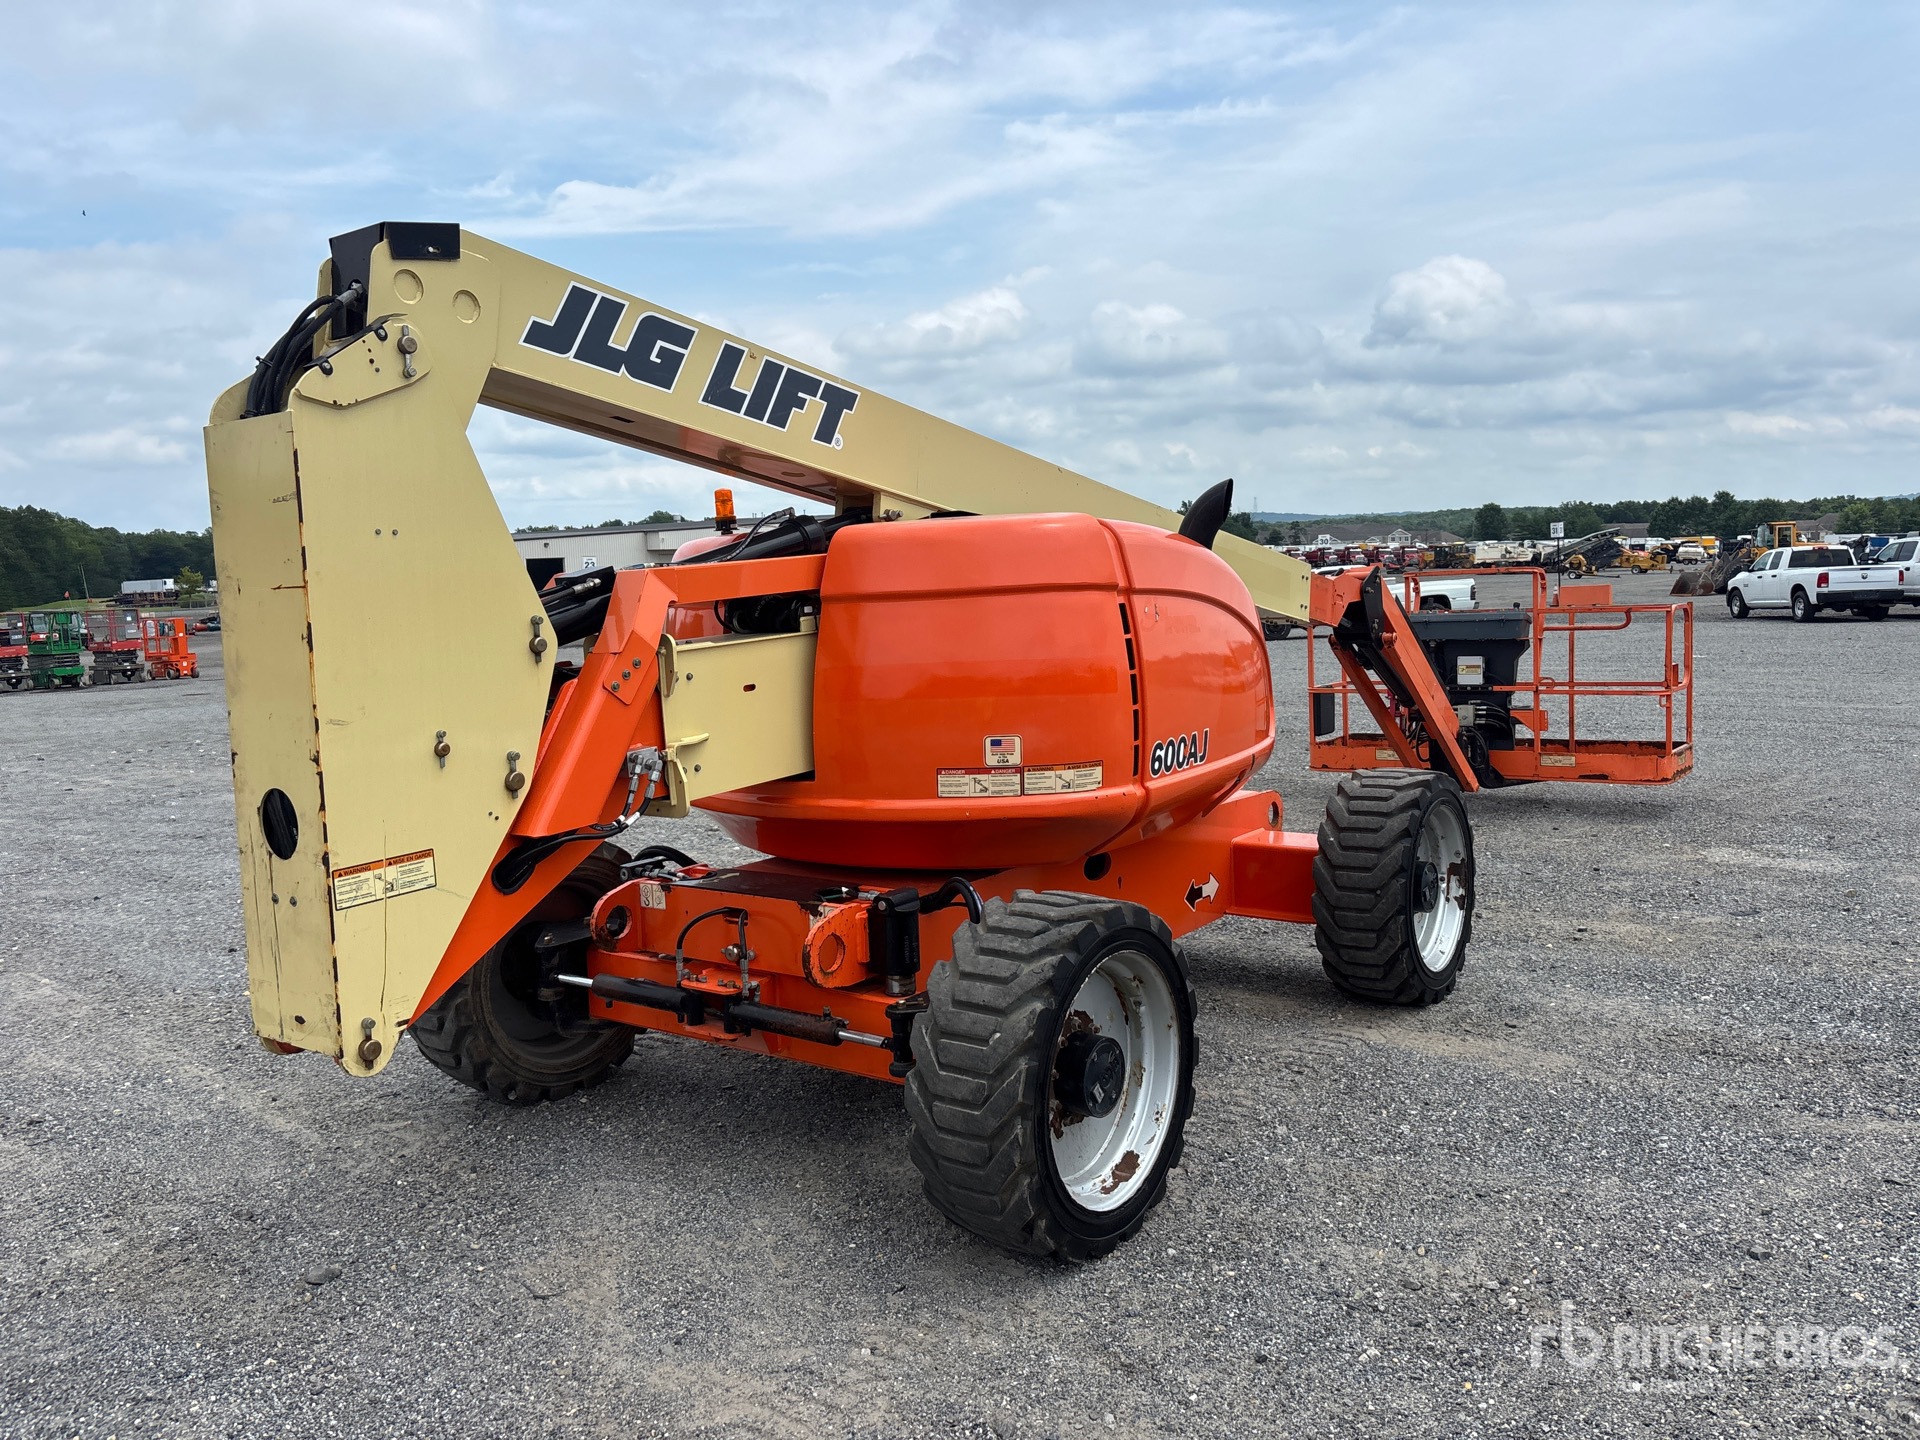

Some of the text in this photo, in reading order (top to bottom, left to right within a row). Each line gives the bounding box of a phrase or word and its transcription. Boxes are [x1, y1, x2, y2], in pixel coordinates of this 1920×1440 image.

[519, 281, 861, 447] JLG LIFT
[1552, 527, 1558, 535] 31
[584, 561, 596, 569] 23
[392, 851, 432, 865] MISE EN GARDE
[343, 865, 372, 877] WARNING
